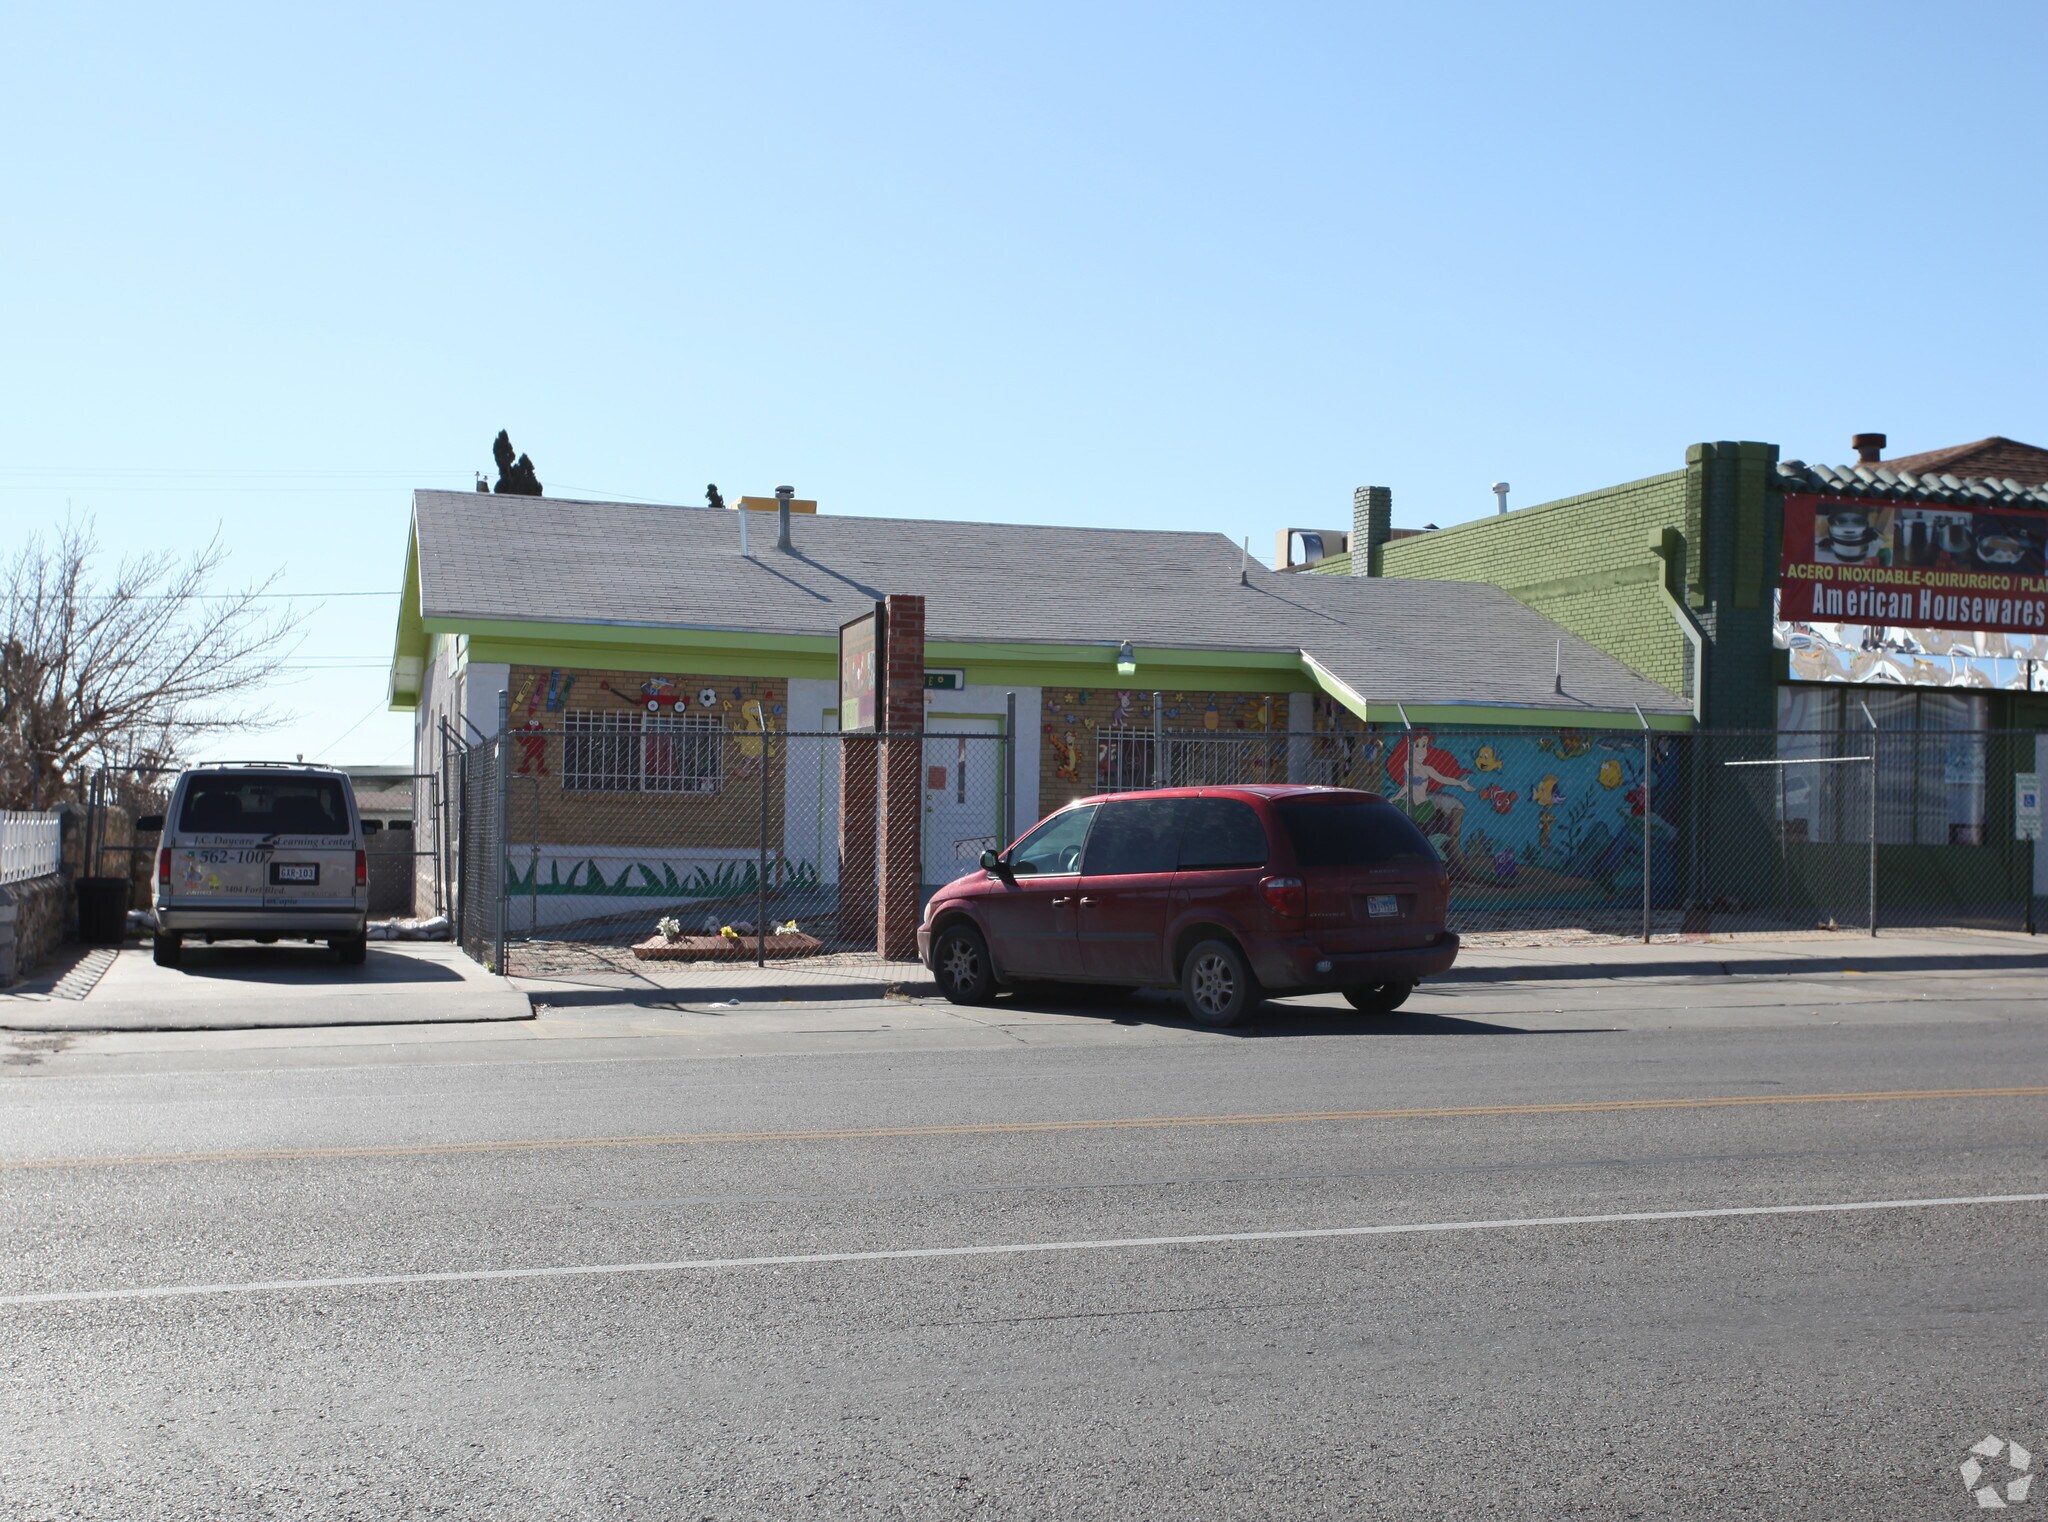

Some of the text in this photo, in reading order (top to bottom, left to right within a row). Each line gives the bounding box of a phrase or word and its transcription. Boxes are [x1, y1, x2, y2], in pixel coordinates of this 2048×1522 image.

[1787, 564, 1834, 580] ACERO
[1838, 568, 2010, 590] INOXIDABLE-QUIRURGICO
[1813, 583, 2046, 627] American Housewares
[214, 836, 254, 846] Daycare
[277, 837, 319, 848] Learning
[200, 850, 274, 865] 562-1007
